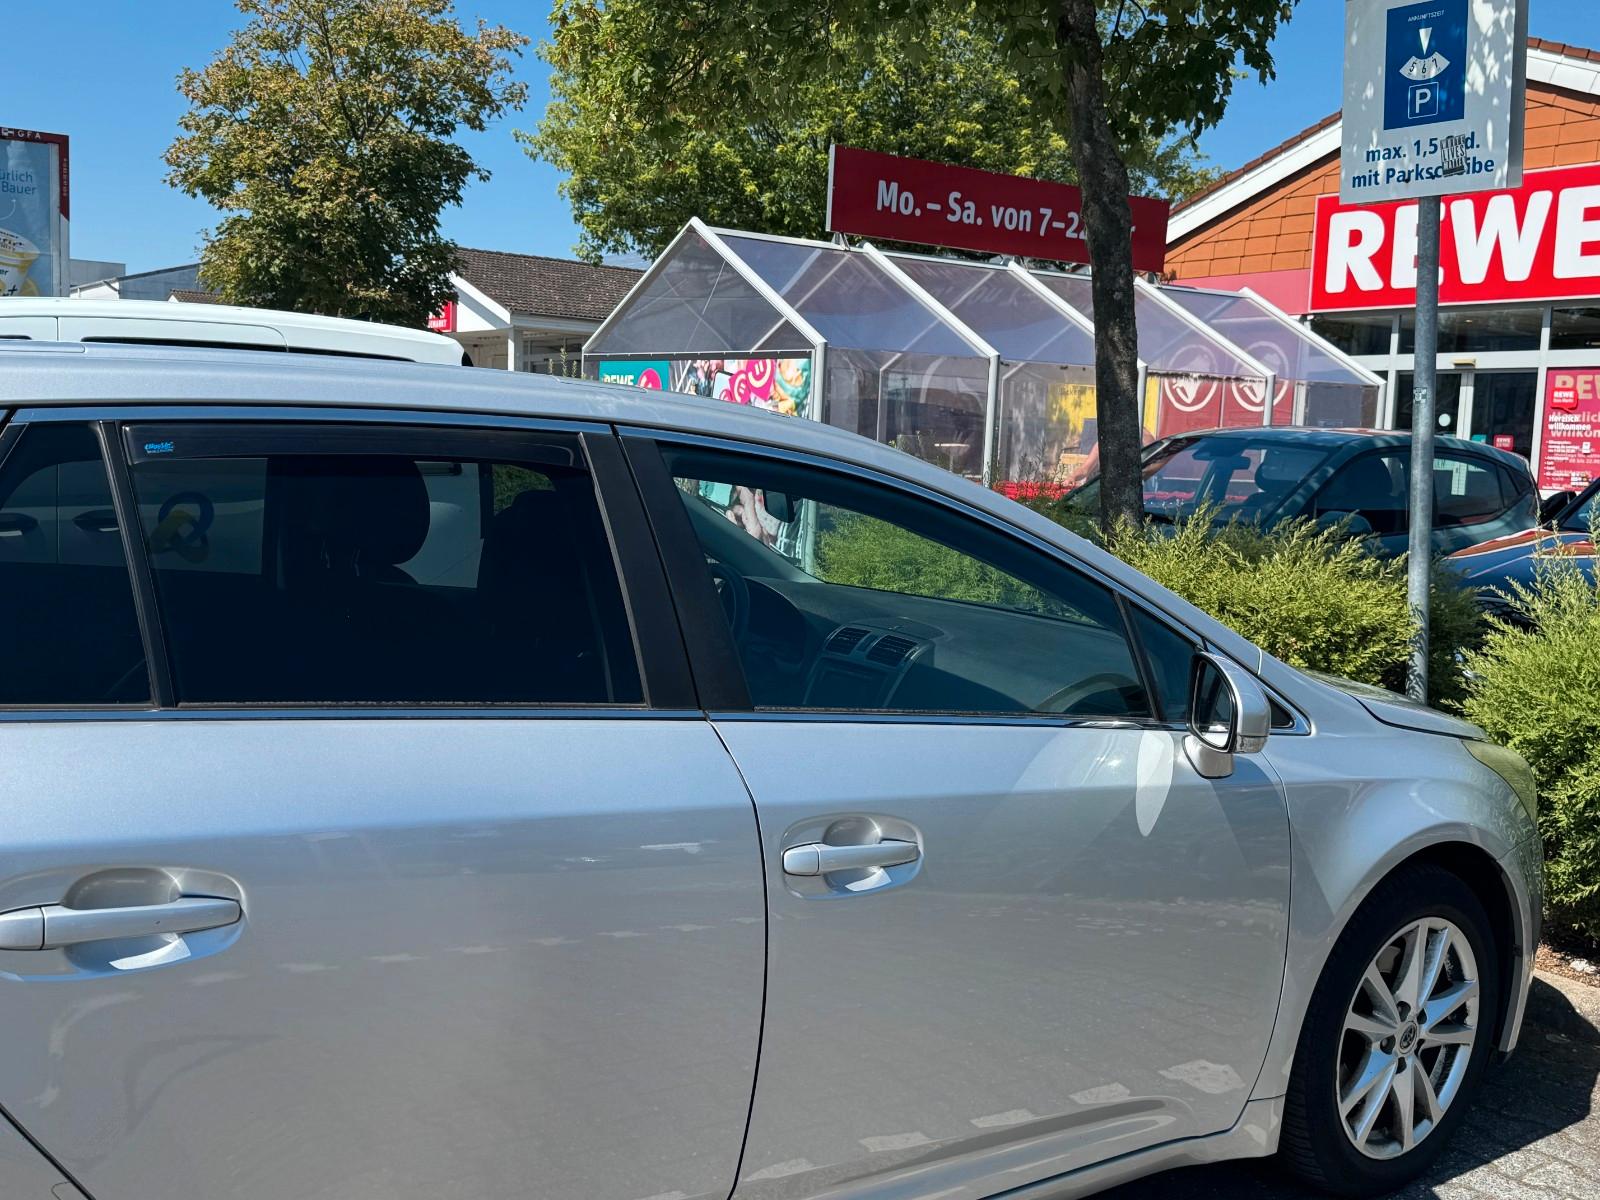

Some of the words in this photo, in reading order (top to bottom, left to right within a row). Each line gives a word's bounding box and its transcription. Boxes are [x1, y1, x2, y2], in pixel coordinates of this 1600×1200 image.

[1409, 62, 1417, 73] 5
[1421, 63, 1427, 74] 6
[1432, 58, 1438, 68] 7
[1415, 88, 1431, 113] P
[1366, 145, 1406, 162] max.
[1413, 138, 1438, 158] 1,5
[1443, 144, 1465, 161] LIVES
[1352, 169, 1380, 188] mit
[1386, 157, 1494, 184] Parkscibe
[1, 180, 37, 195] Bauer
[876, 180, 921, 216] Mo.
[947, 191, 983, 226] Sa.
[991, 205, 1032, 232] von
[1325, 184, 1600, 294] REWE
